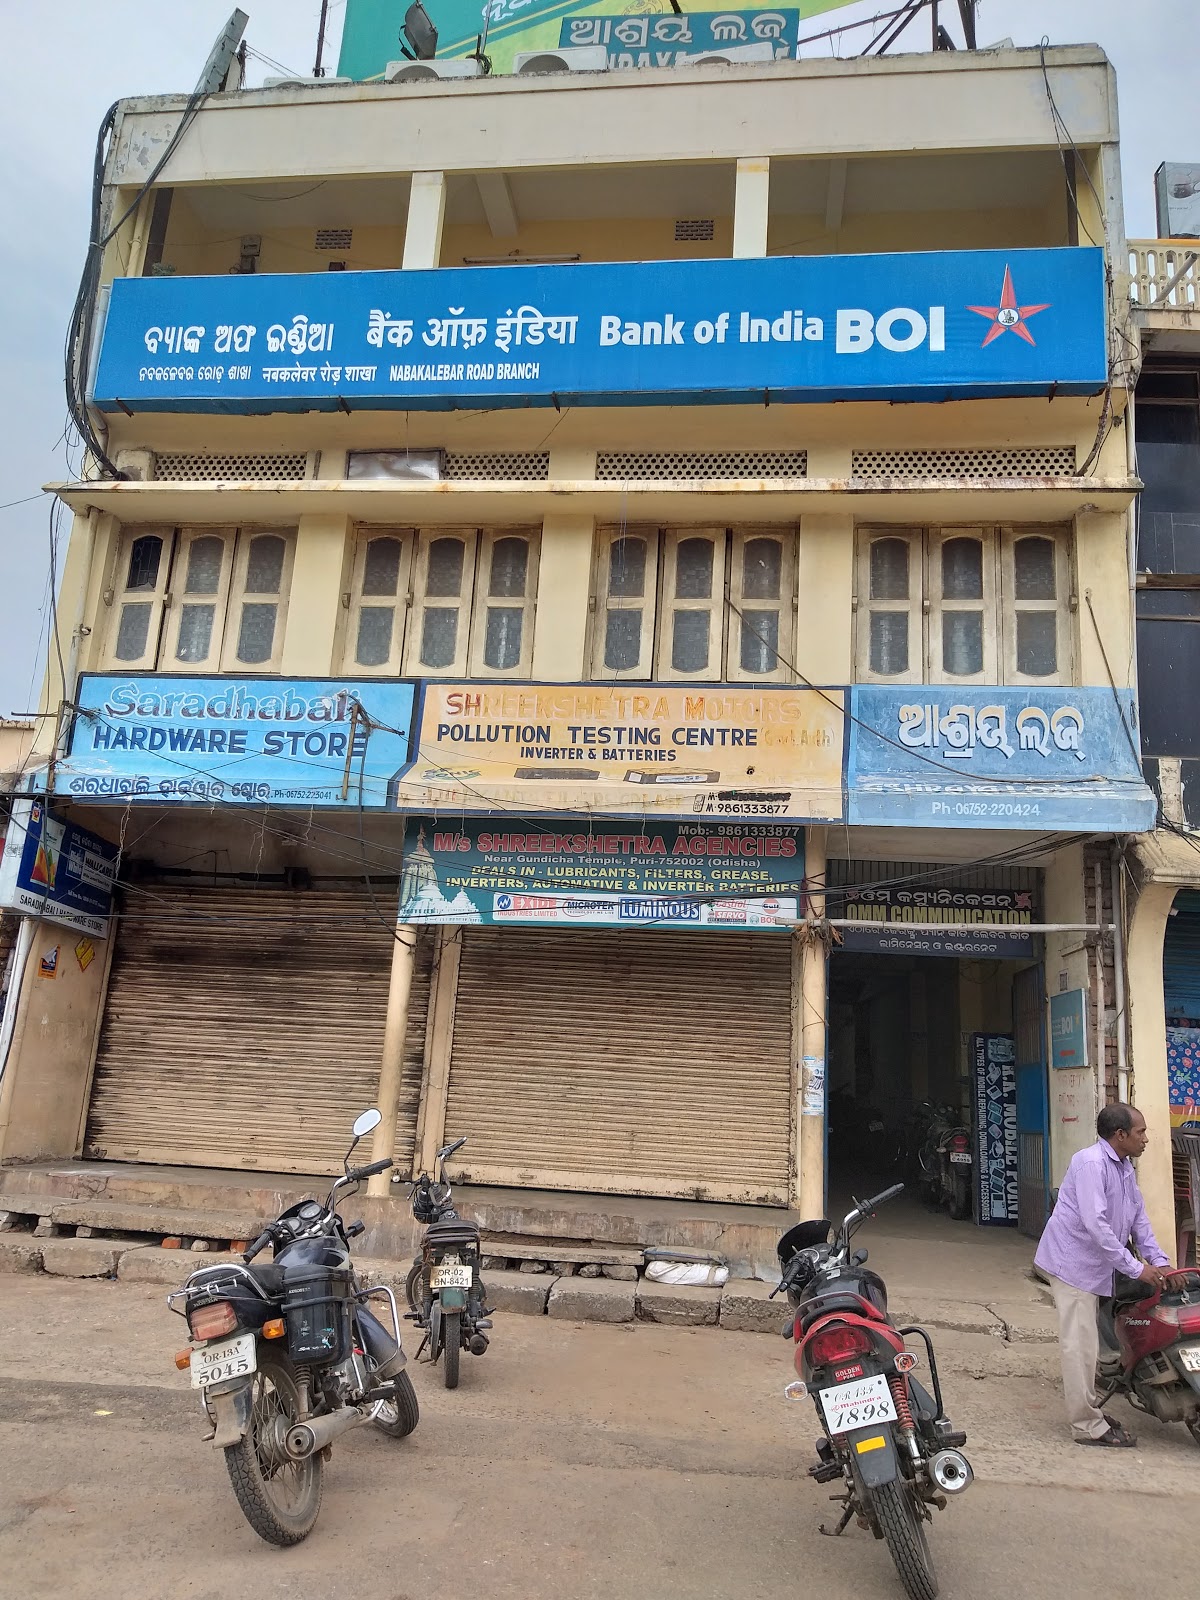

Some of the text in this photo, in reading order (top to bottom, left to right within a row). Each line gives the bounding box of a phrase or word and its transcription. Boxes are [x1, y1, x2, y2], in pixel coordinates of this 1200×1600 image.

[366, 305, 579, 353] बैंक ऑफ़ इंडिया
[600, 309, 824, 346] Bank of India
[835, 306, 945, 354] BOI
[345, 365, 378, 382] शाखा
[389, 362, 540, 382] NABAKALEBAR ROAD BRANCH
[104, 682, 362, 723] Saradhabali
[446, 693, 802, 723] SHREEKSHETRA MOTORS
[92, 725, 368, 758] HARDWARE STORE
[437, 723, 551, 744] POLLUTION
[567, 726, 661, 746] TESTING
[671, 727, 758, 746] CENTRE
[520, 746, 677, 762] INVERTER & BATTERIES
[932, 801, 1041, 817] Ph-06752-220424
[717, 825, 800, 837] 9861333877
[433, 832, 797, 858] M/s SHREEKSHETRA AGENCIES
[484, 855, 761, 869] Near Gundicha Temple, Puri-752002 (Odisha)
[471, 865, 517, 876] DEALS
[520, 866, 535, 876] IN
[546, 866, 640, 881] LUBRICANTS,
[644, 868, 707, 883] FILTERS,
[711, 870, 773, 882] GREASE,
[446, 877, 799, 894] INVERTERS, AUTOMATIVE & INVERTER BATTERIES
[513, 896, 557, 910] EXIDE
[567, 901, 614, 910] MICROTEK
[620, 898, 699, 919] LUMINOUS
[534, 910, 558, 918] LIMITED
[716, 911, 746, 919] SERVO
[760, 916, 776, 924] BOS
[847, 903, 1031, 925] OMM COMMUNICATION
[1061, 1016, 1073, 1034] BOI
[976, 1036, 984, 1048] ALL
[976, 1048, 985, 1067] TYPES
[977, 1067, 985, 1076] OF
[977, 1076, 986, 1098] MOBILE
[978, 1098, 987, 1130] REPAIRING,
[979, 1131, 988, 1174] DOWNLOADING
[980, 1180, 990, 1221] ACCESSORIES
[437, 1269, 464, 1277] OR-02
[204, 1346, 241, 1364] OR-13A
[198, 1359, 250, 1385] 5045
[835, 1366, 860, 1378] GOLDEN
[833, 1400, 890, 1429] 1898
